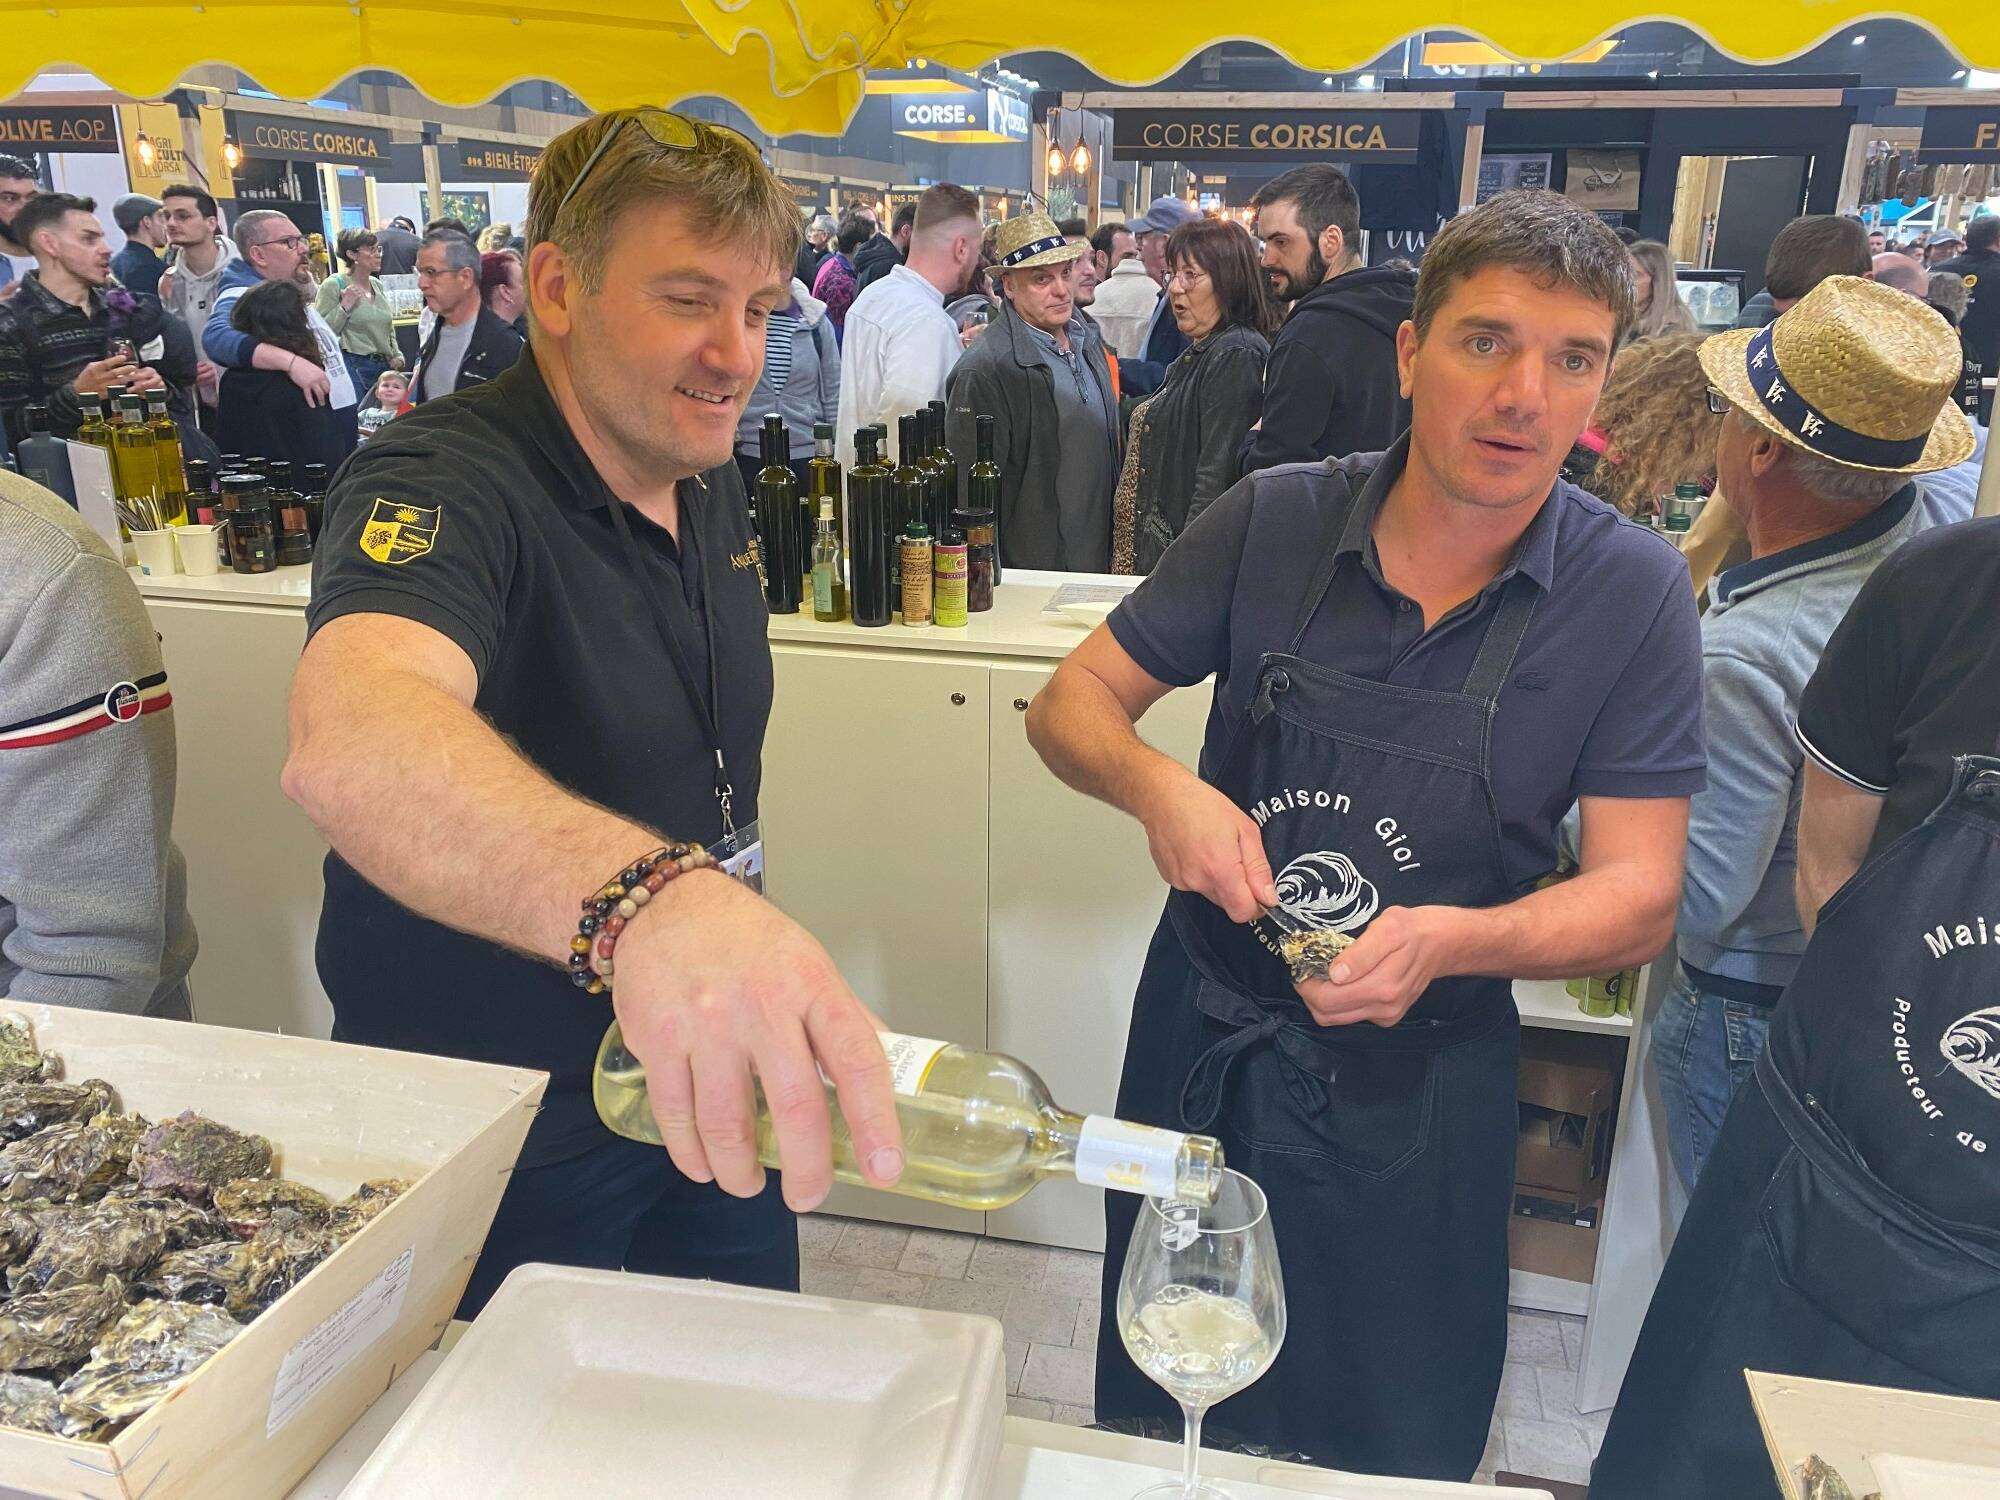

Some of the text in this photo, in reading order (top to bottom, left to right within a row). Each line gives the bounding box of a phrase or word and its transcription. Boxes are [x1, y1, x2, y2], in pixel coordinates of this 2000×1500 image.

[60, 119, 105, 141] AOP
[255, 126, 378, 158] CORSE CORSICA
[1143, 123, 1387, 149] CORSE CORSICA
[1250, 788, 1421, 872] Maison Giol
[1893, 997, 1987, 1154] Producteur de
